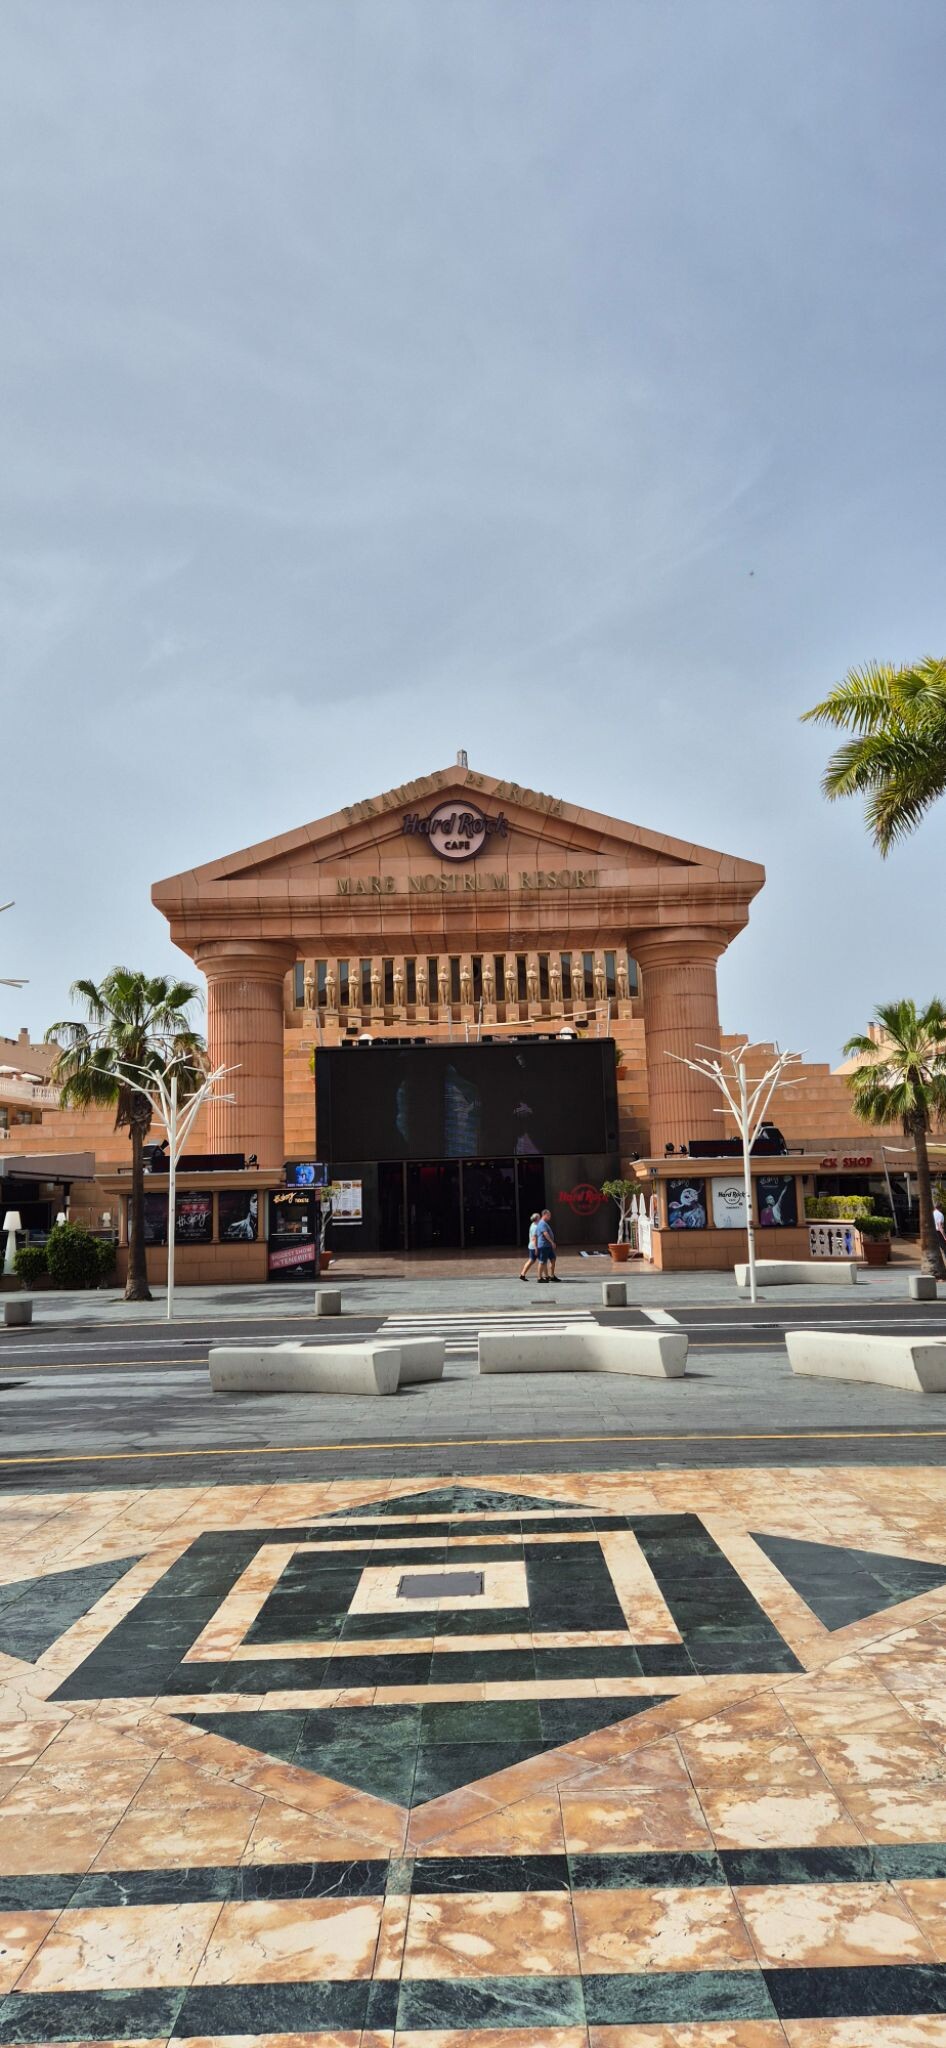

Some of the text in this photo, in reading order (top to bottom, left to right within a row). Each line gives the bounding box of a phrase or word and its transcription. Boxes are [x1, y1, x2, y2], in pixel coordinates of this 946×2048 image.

[403, 812, 508, 838] Hard Rock
[444, 841, 470, 850] CAFE
[336, 869, 600, 895] MARE NOSTRUM RESORT
[842, 1157, 873, 1168] SHOP
